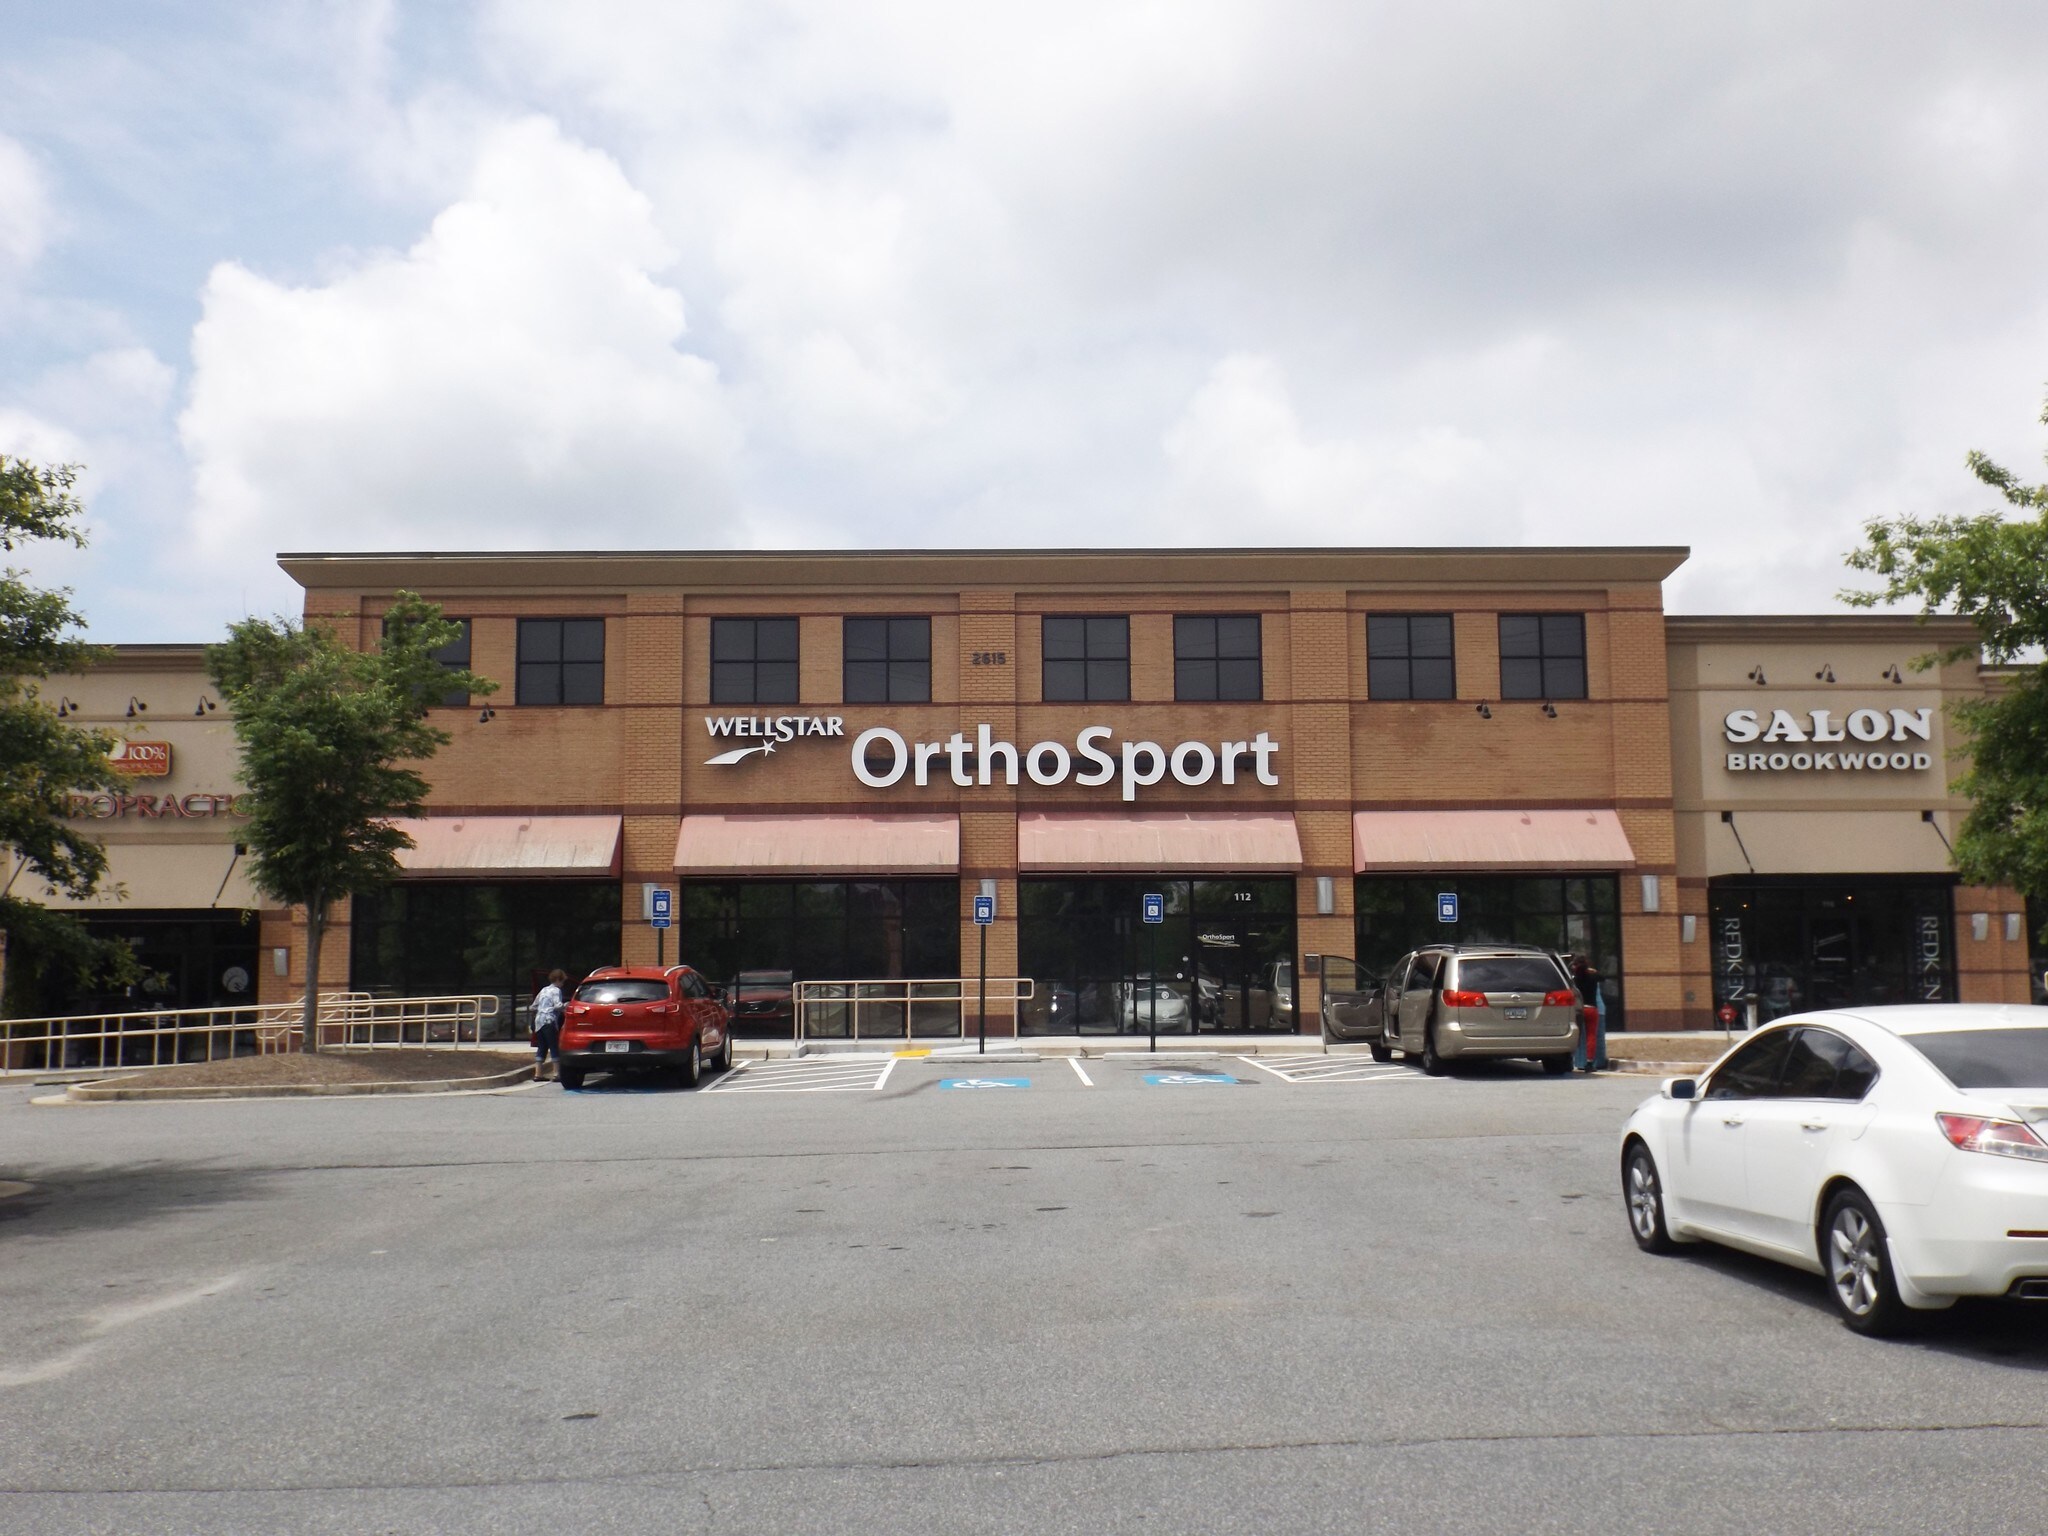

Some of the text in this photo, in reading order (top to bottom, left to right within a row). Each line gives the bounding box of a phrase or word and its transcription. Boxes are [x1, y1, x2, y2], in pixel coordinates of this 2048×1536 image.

[971, 651, 1007, 665] 2615
[704, 716, 844, 743] WELLSTAR
[1724, 708, 1934, 743] SALON
[128, 745, 167, 761] 100%
[851, 723, 1279, 802] OrthoSport
[1727, 752, 1932, 771] BROOKWOOD
[1234, 893, 1252, 901] 112
